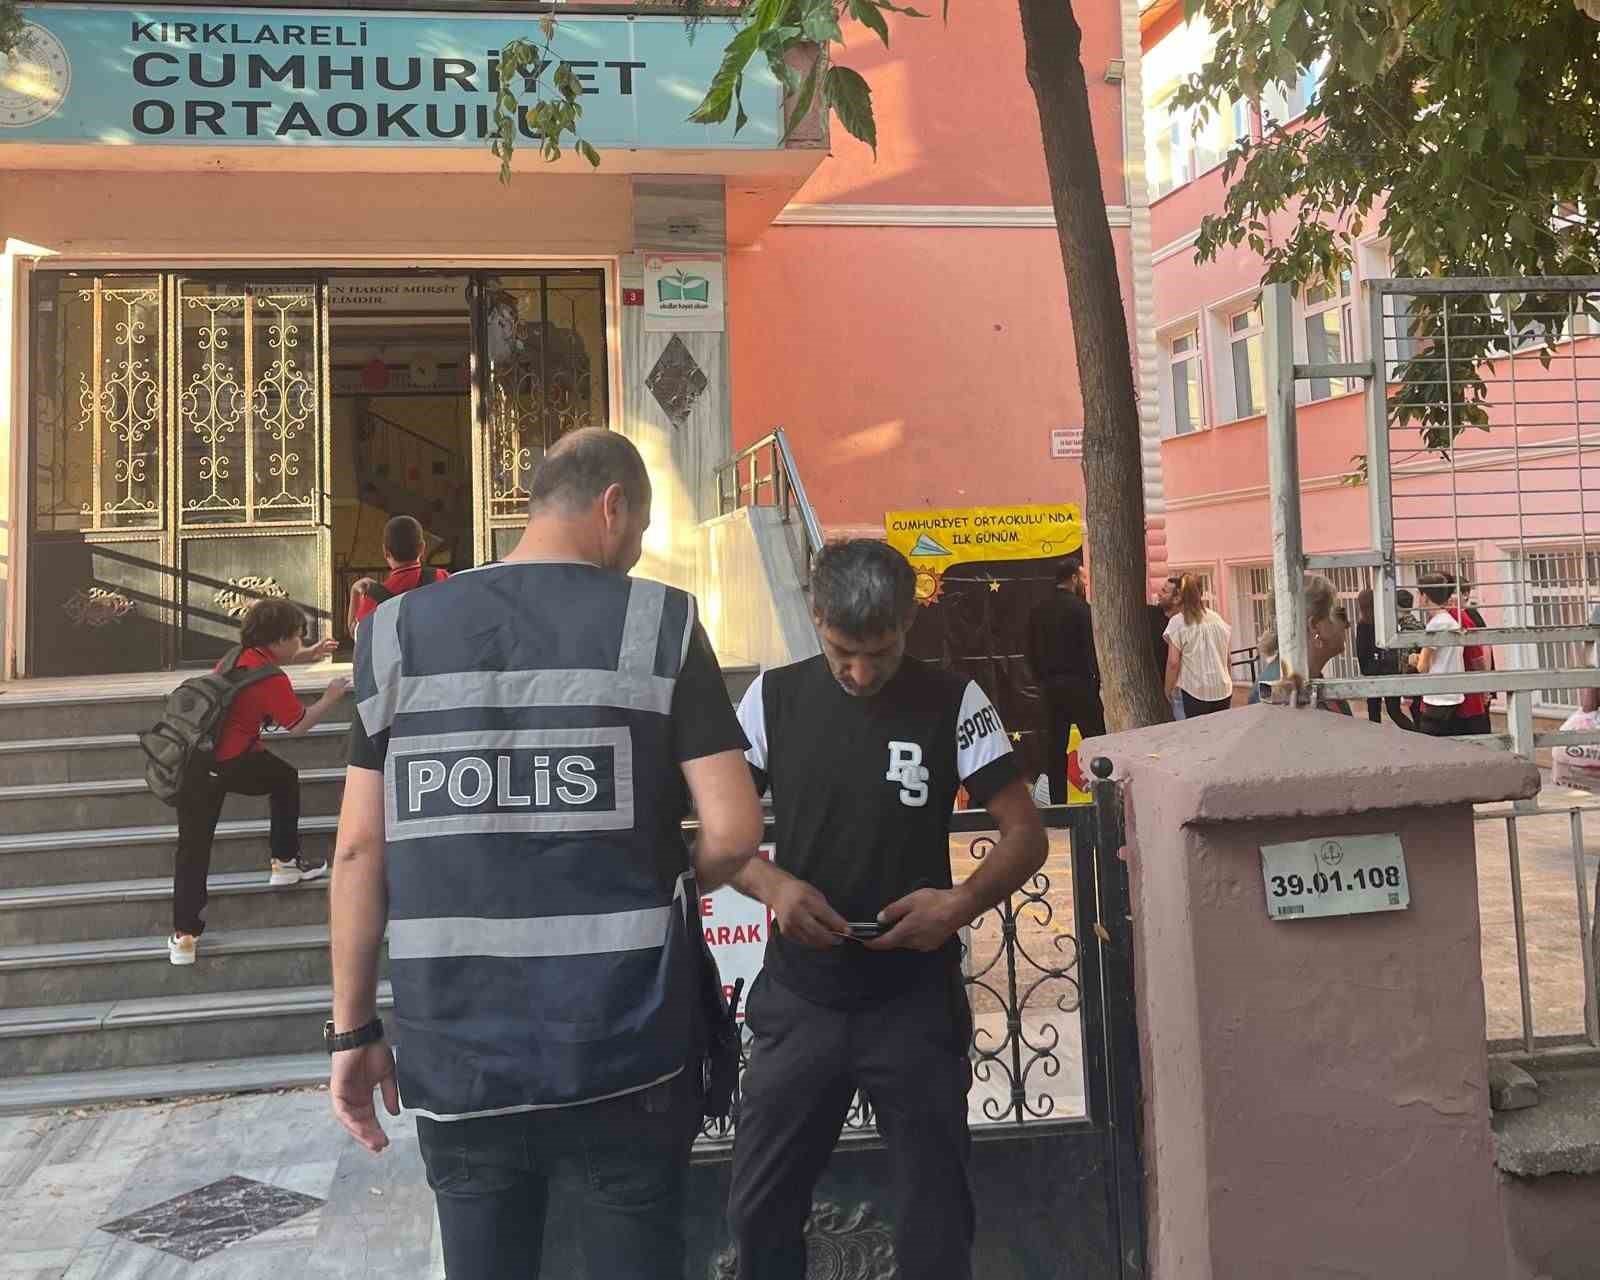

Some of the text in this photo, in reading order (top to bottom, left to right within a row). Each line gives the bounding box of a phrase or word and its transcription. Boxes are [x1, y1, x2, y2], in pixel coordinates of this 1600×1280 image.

[131, 21, 367, 47] KIRKLARELİ
[132, 49, 647, 95] CUMHURİYET
[630, 292, 637, 302] 3
[1271, 865, 1400, 898] 39.01.108
